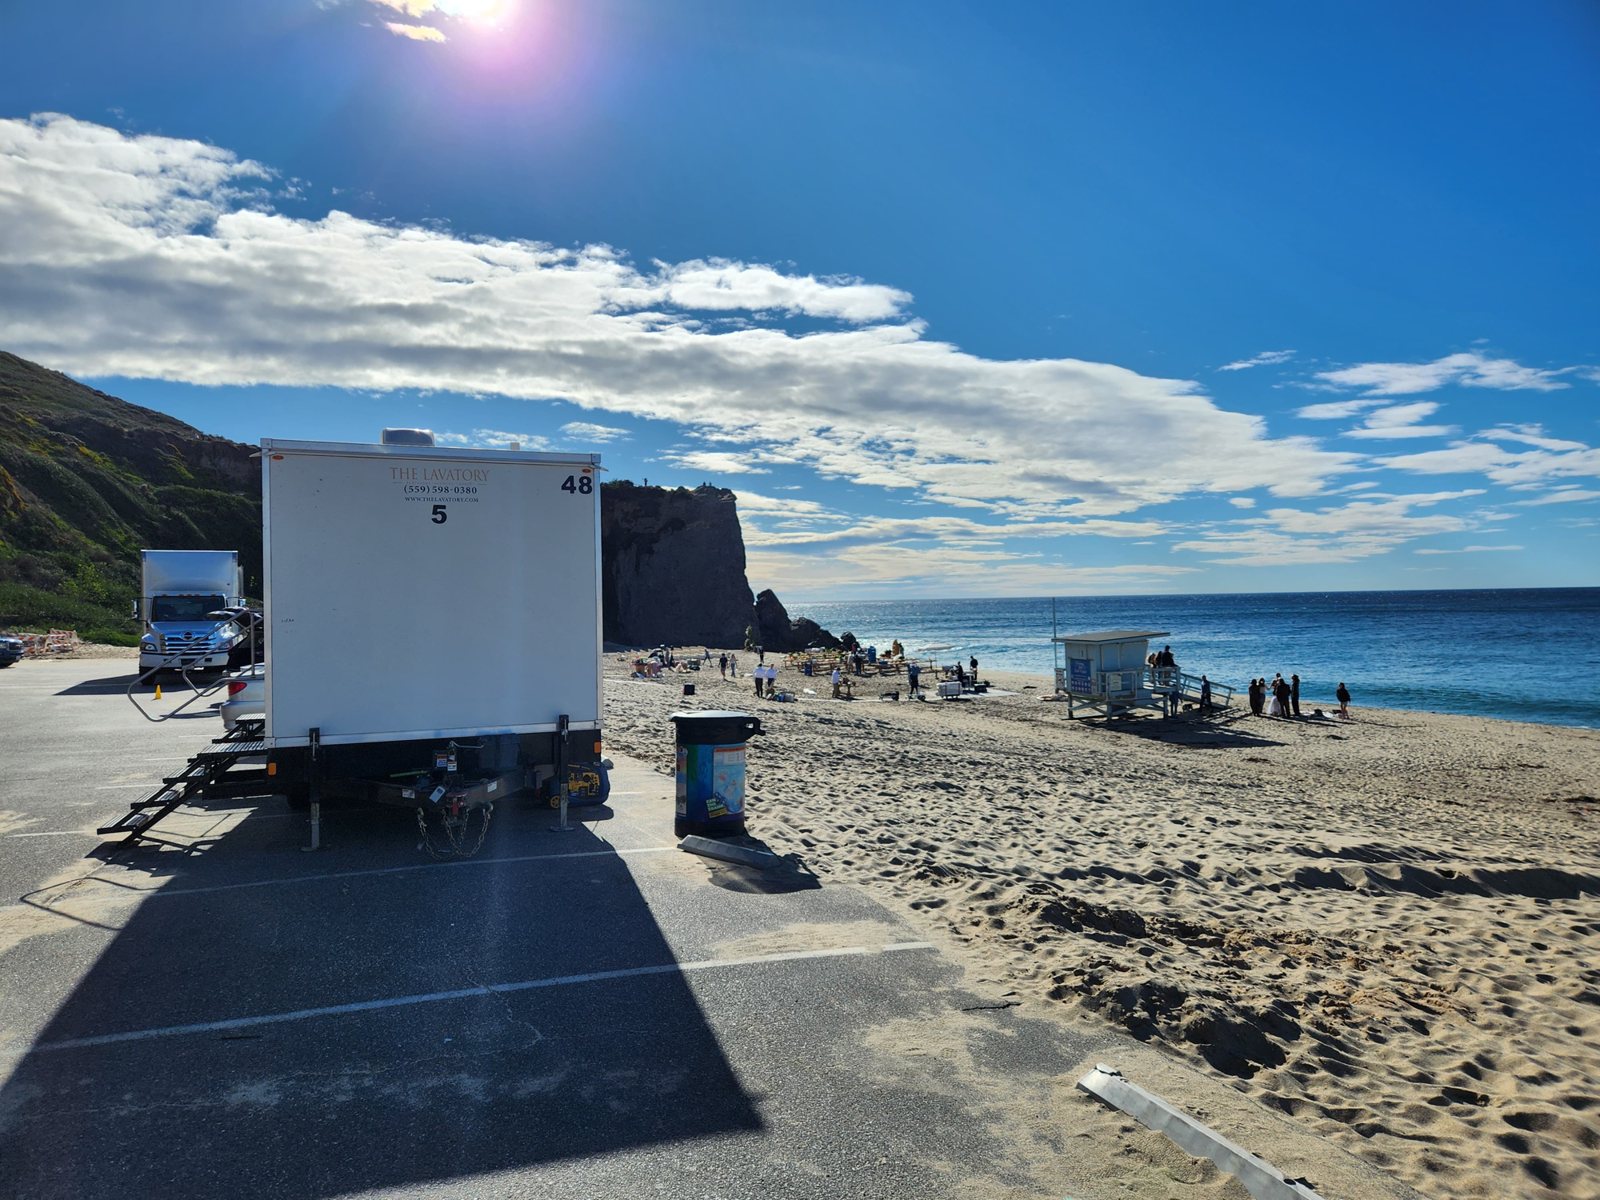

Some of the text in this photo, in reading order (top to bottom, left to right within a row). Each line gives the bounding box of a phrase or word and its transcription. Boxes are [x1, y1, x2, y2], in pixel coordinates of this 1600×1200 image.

[390, 467, 490, 481] THE LAVATORY
[404, 485, 477, 494] (559) 598-0380
[561, 475, 593, 495] 48
[431, 504, 448, 524] 5
